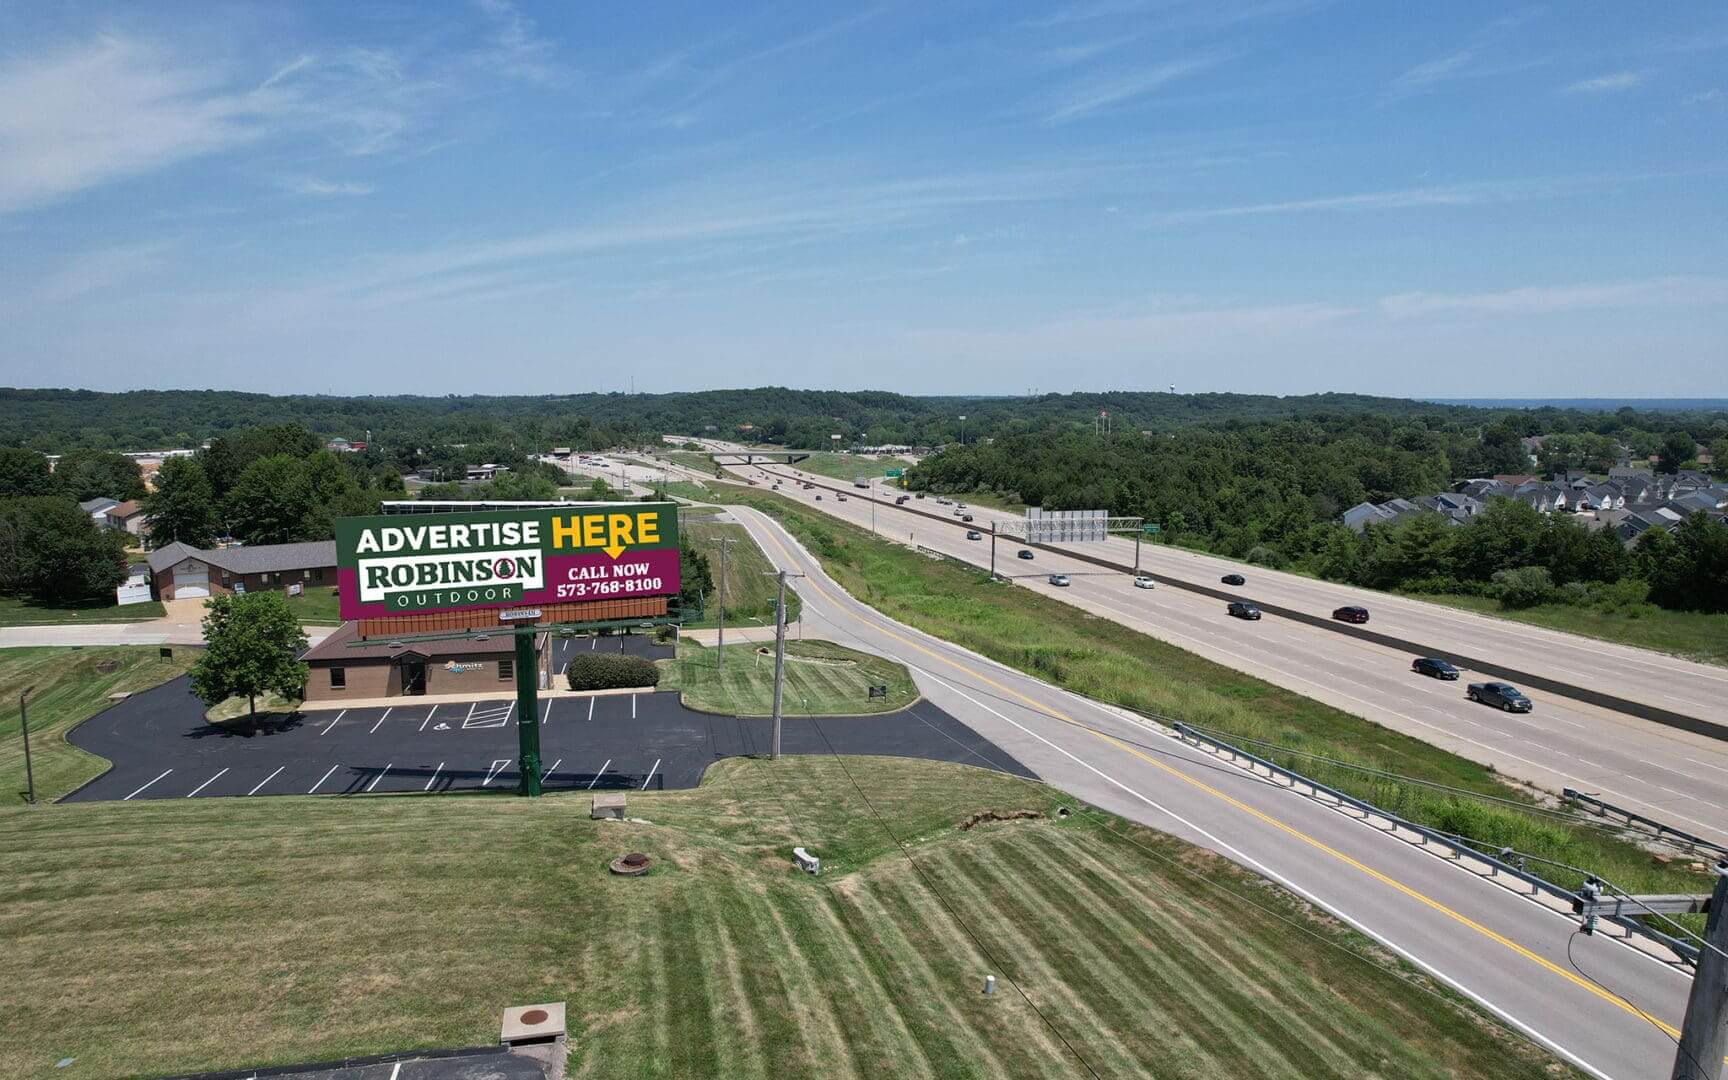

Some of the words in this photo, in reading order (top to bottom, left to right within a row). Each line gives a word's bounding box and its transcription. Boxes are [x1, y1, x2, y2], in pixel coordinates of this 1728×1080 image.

[356, 521, 540, 553] ADVERTISE
[551, 512, 660, 549] HERE
[365, 556, 537, 589] ROBINSON
[568, 566, 609, 581] CALL
[612, 563, 650, 577] NOW
[397, 587, 512, 607] OUTDOOR
[557, 577, 662, 598] 573-768-8100
